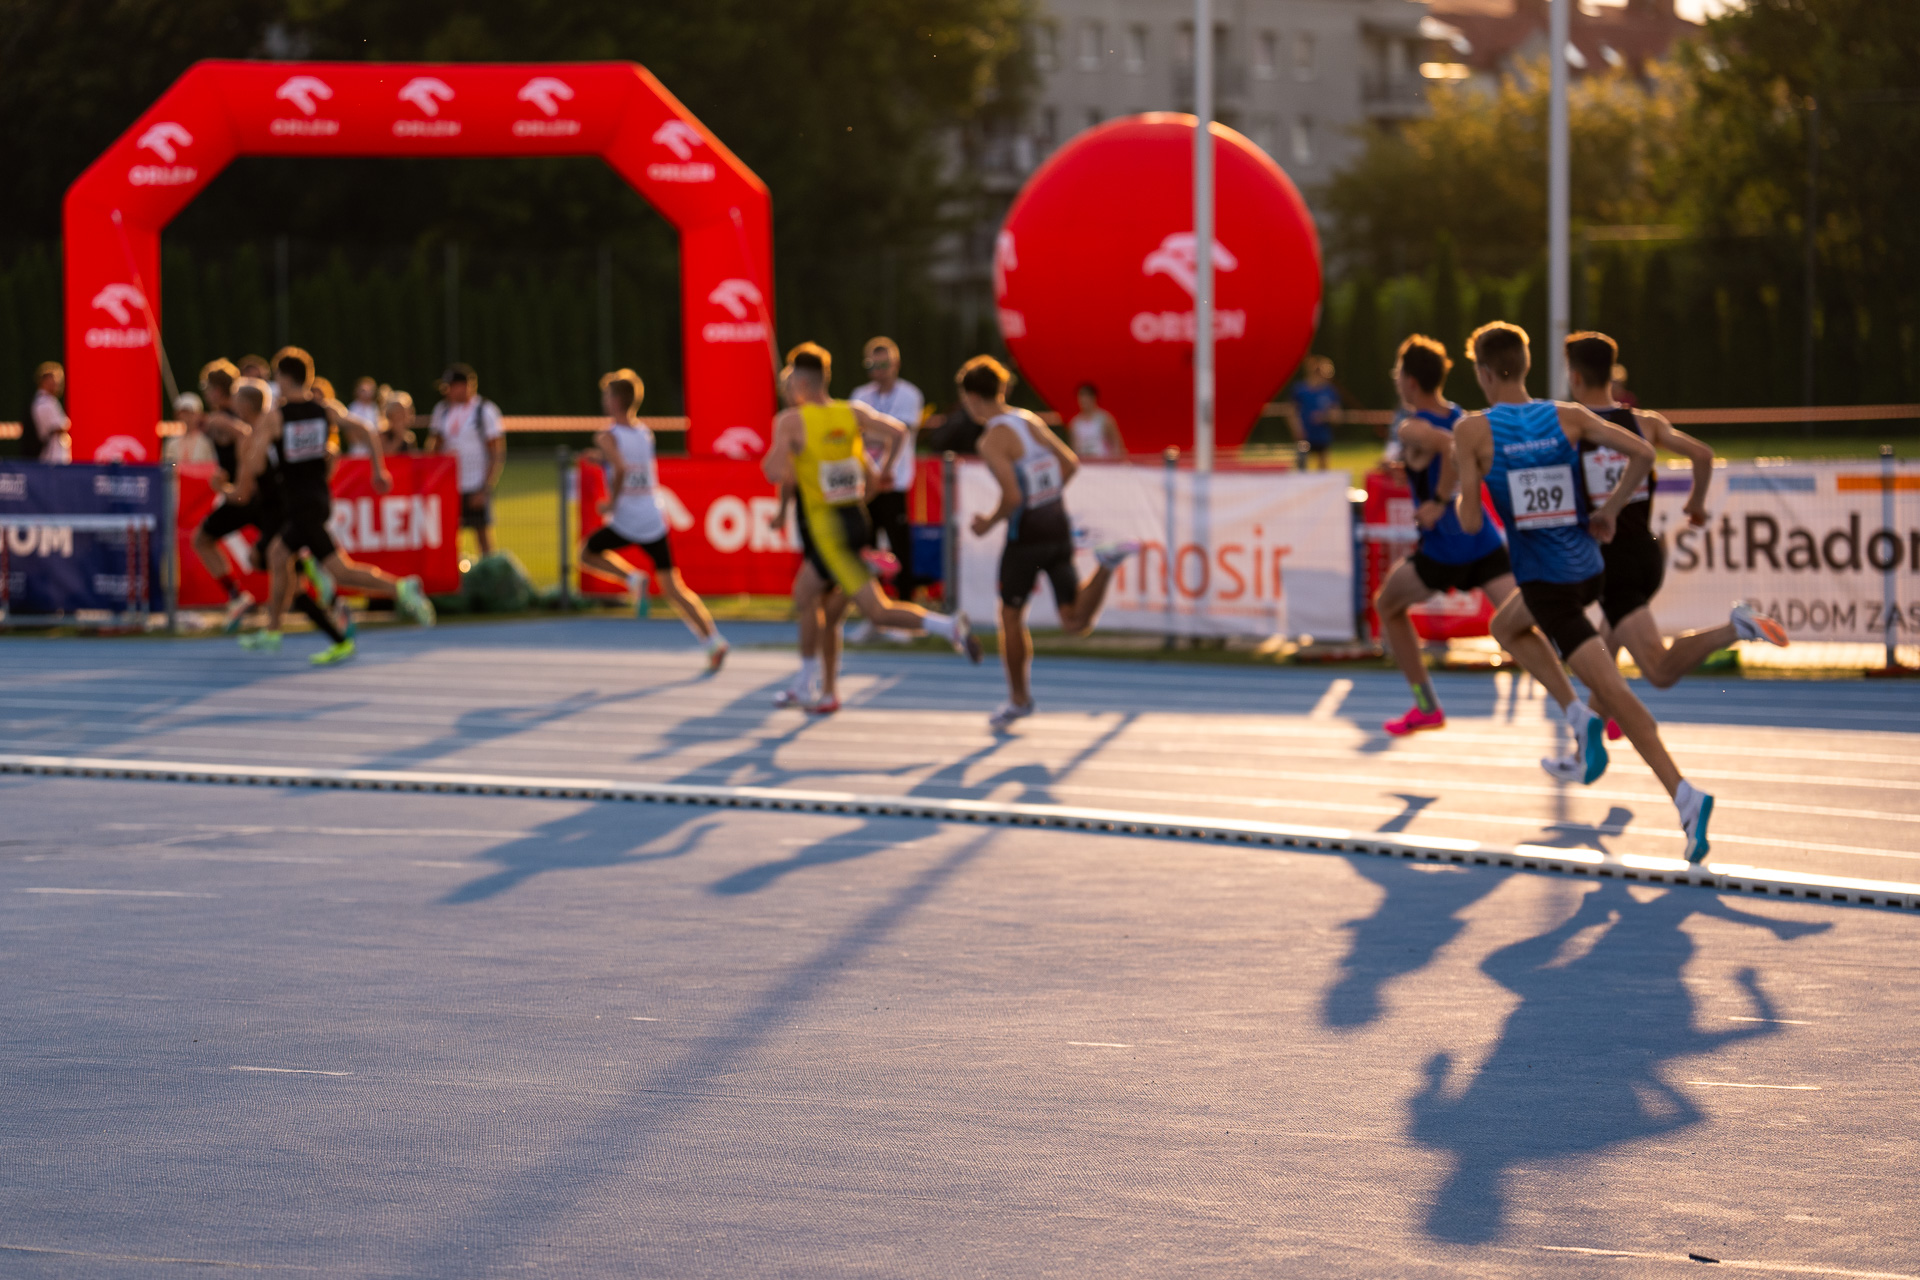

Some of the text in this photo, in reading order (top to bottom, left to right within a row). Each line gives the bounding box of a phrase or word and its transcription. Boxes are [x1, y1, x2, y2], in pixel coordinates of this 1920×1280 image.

[269, 118, 340, 137] ORLEN
[391, 119, 462, 138] ORLEN
[511, 119, 582, 137] ORLEN
[1523, 484, 1564, 513] 289
[328, 494, 443, 554] RLEN
[704, 494, 804, 554] ORL
[1658, 511, 1920, 573] isitRado
[1115, 524, 1292, 602] mosir
